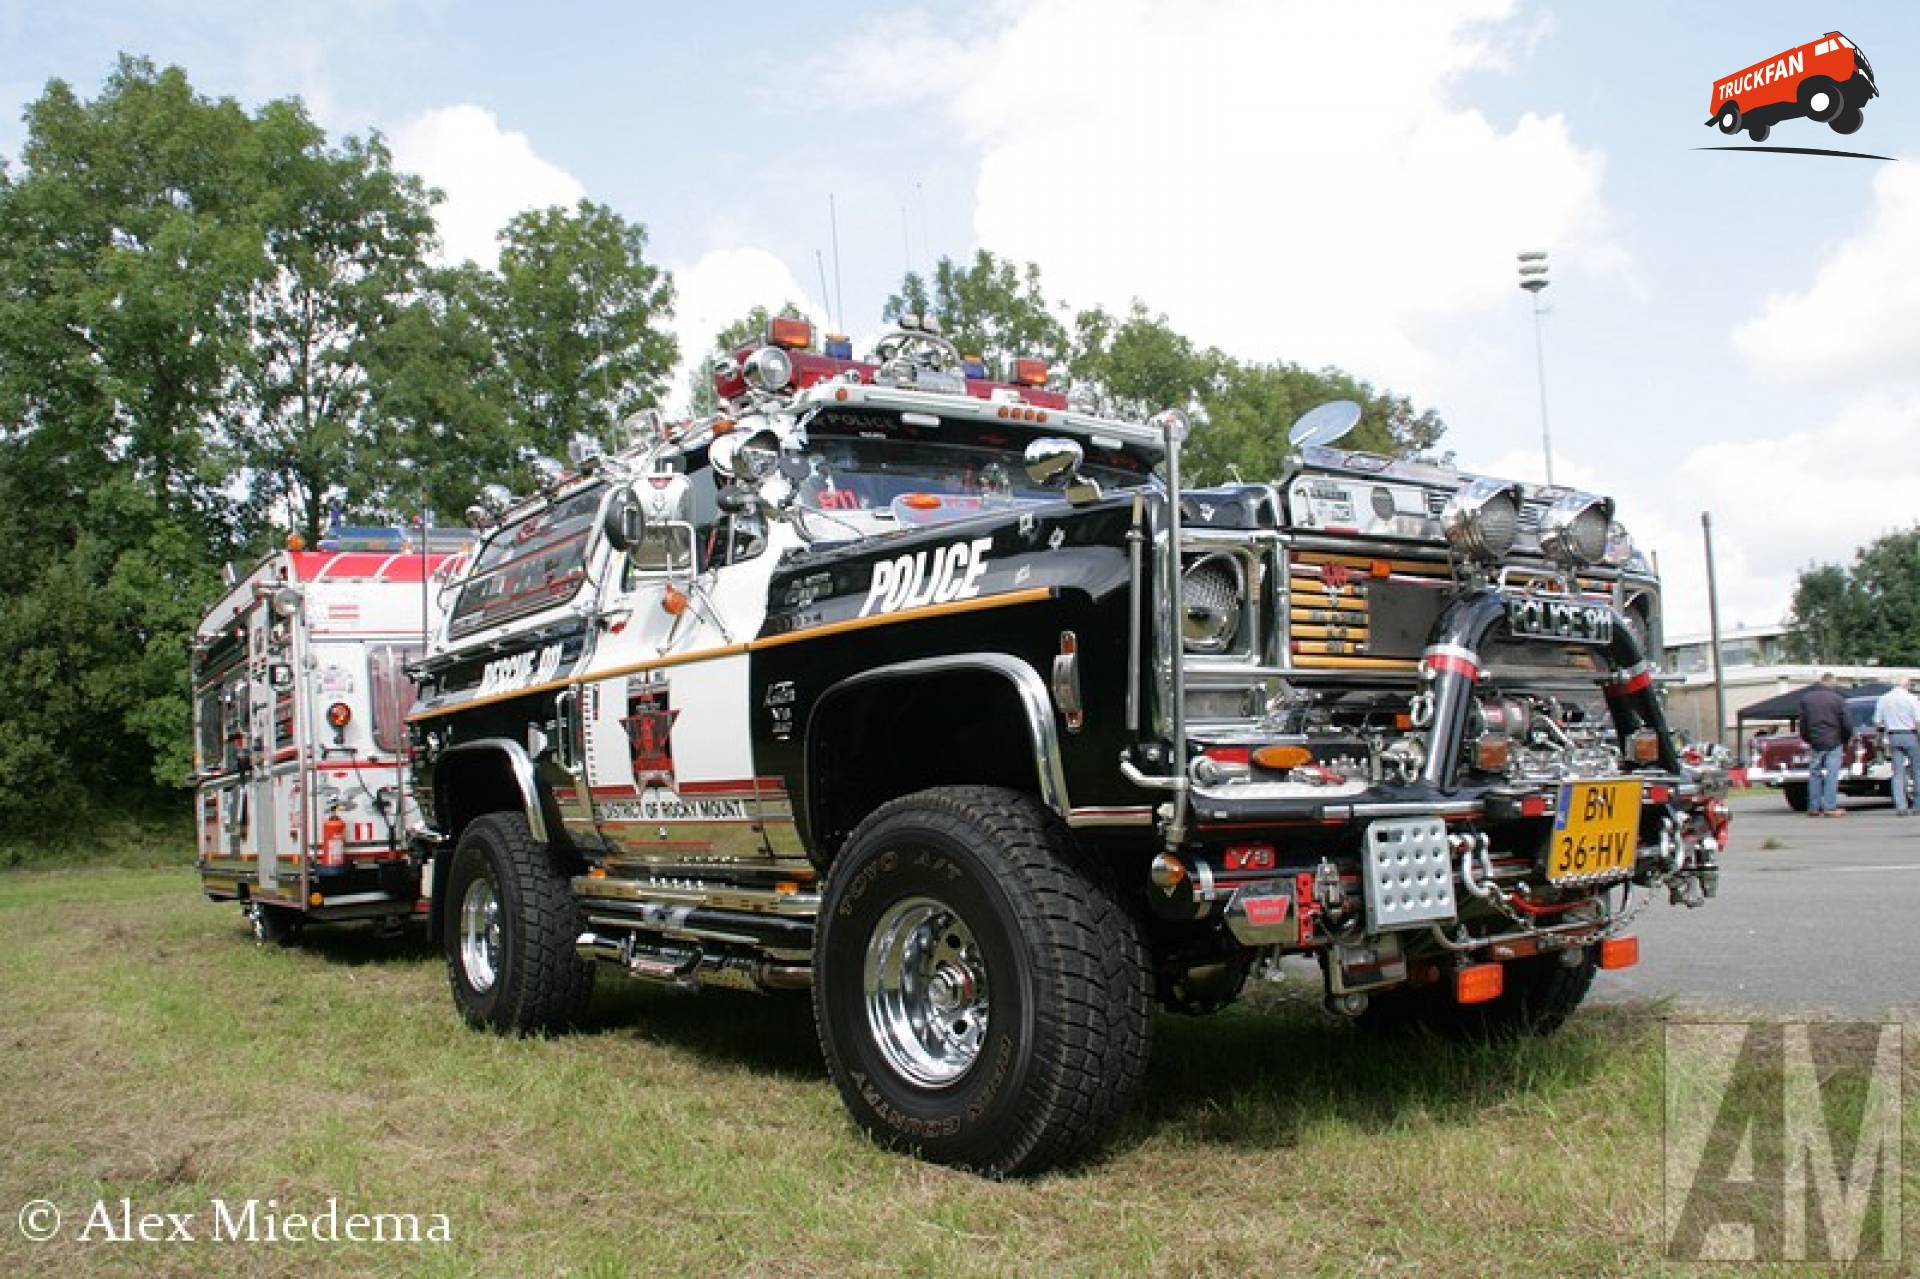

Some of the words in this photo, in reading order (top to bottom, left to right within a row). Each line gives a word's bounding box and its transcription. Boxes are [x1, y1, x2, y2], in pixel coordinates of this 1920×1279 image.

[858, 537, 993, 618] POLICE
[645, 801, 658, 818] OF
[700, 800, 744, 818] MOUNT
[1584, 787, 1616, 821] BN
[1559, 832, 1628, 872] 36-HV
